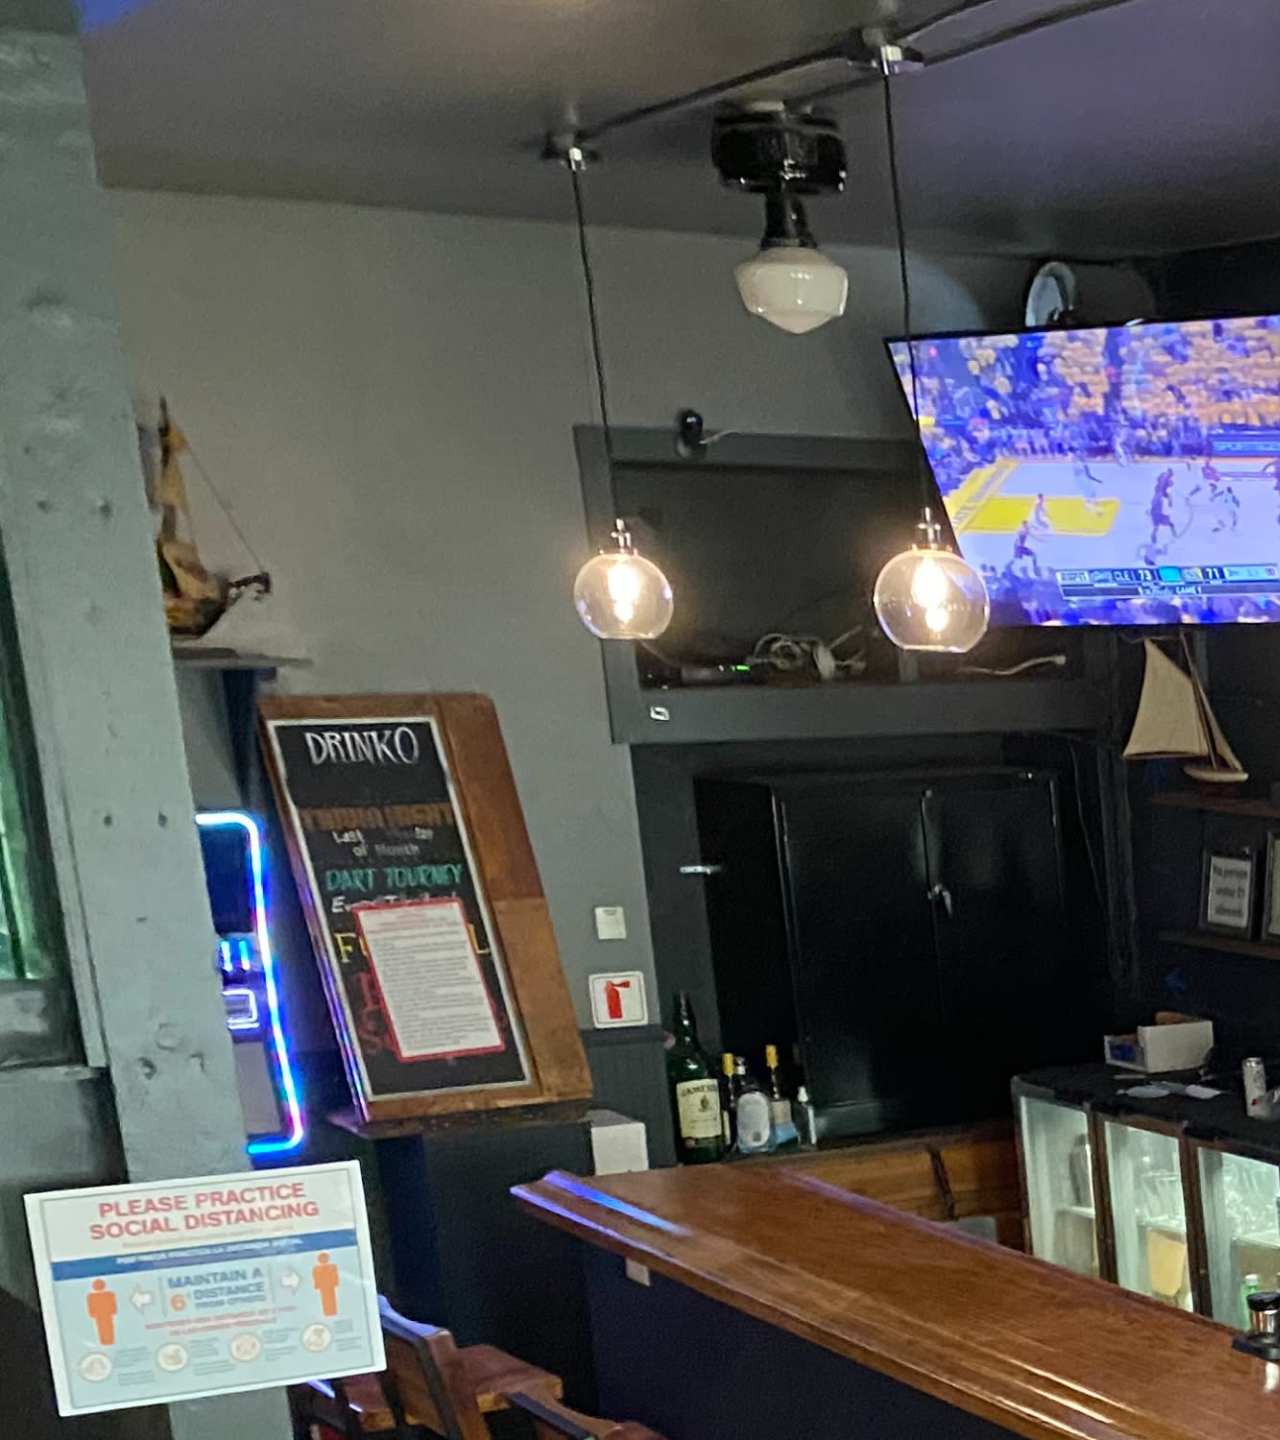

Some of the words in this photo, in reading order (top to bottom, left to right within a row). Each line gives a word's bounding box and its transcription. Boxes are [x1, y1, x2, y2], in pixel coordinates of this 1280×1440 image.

[304, 726, 419, 765] DRINKO
[324, 868, 376, 892] DART
[383, 863, 463, 888] TOURNEY
[98, 1194, 188, 1218] PLEASE
[194, 1182, 306, 1209] PRACTICE
[89, 1217, 177, 1240] SOCIAL
[184, 1201, 320, 1230] DISTANCING
[168, 1269, 248, 1289] MAINTAIN
[251, 1267, 264, 1279] A
[193, 1281, 265, 1300] DISTANCE
